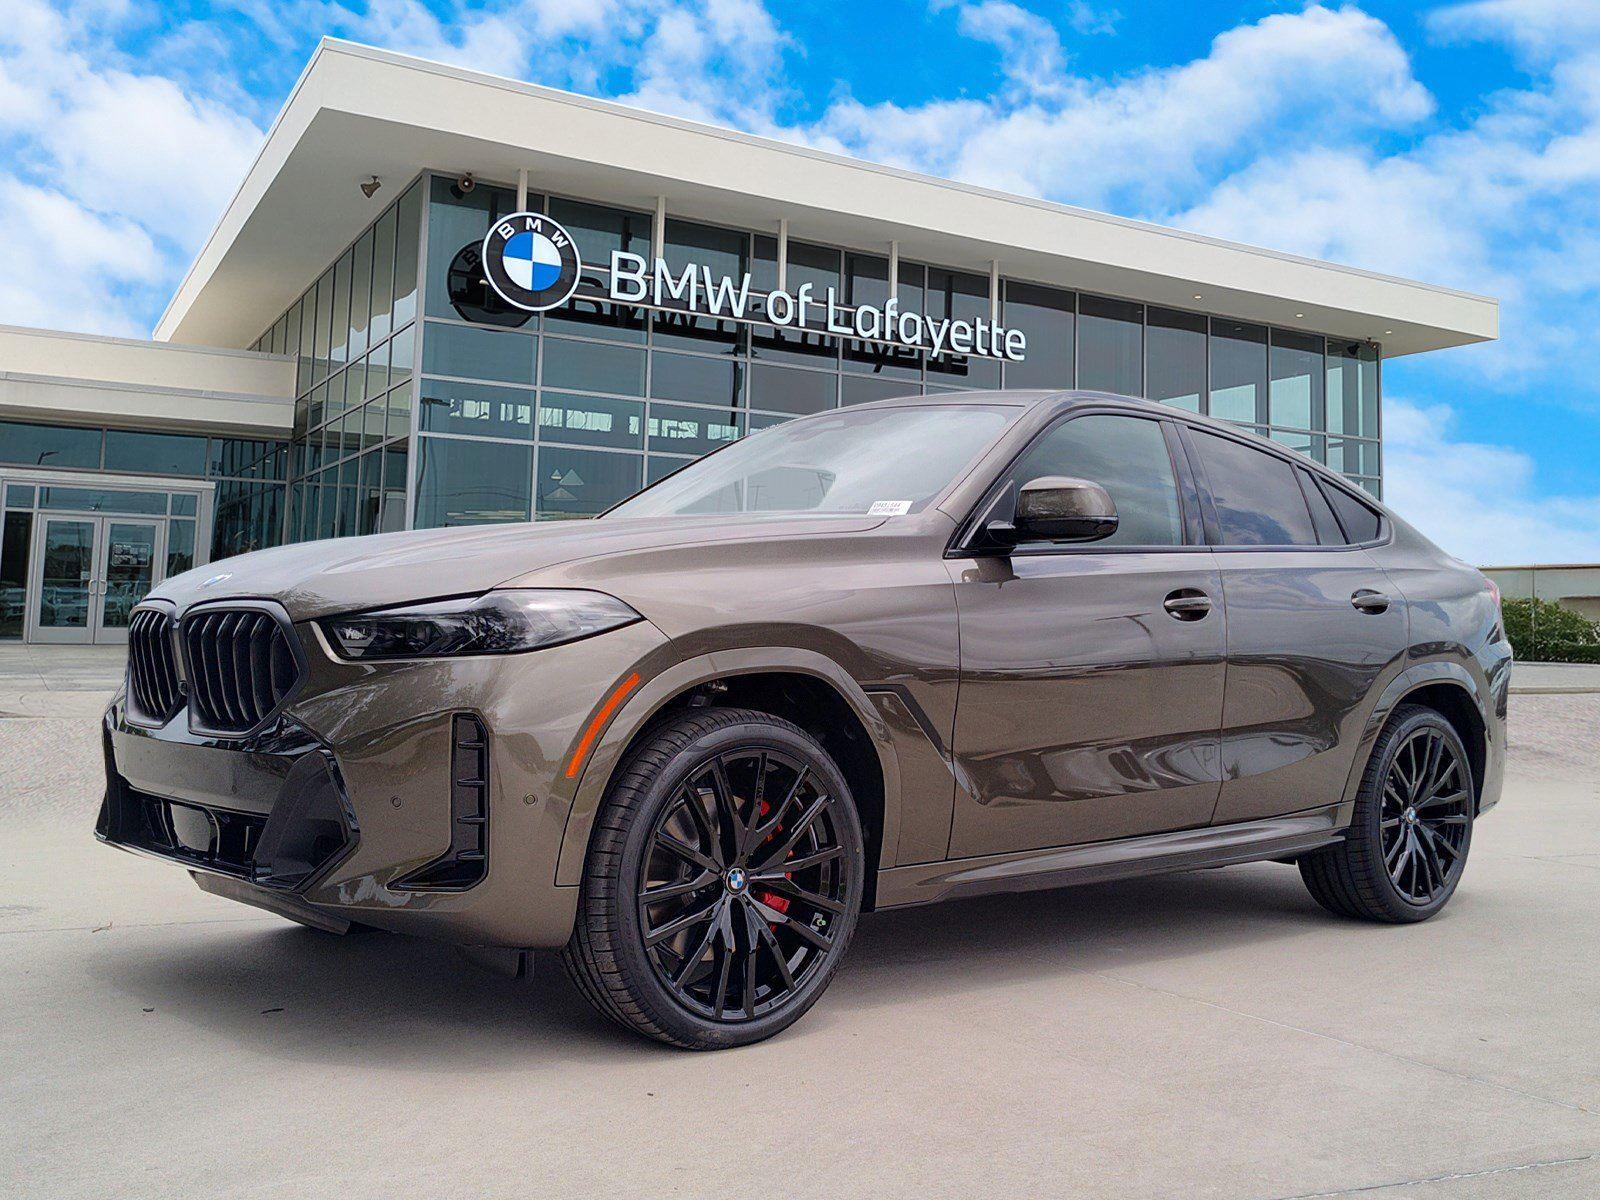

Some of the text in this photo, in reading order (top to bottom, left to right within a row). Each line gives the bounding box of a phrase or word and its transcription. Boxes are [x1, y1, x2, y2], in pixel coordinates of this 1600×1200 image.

[497, 217, 570, 249] BMW
[609, 250, 1027, 361] BMW of Lafayette
